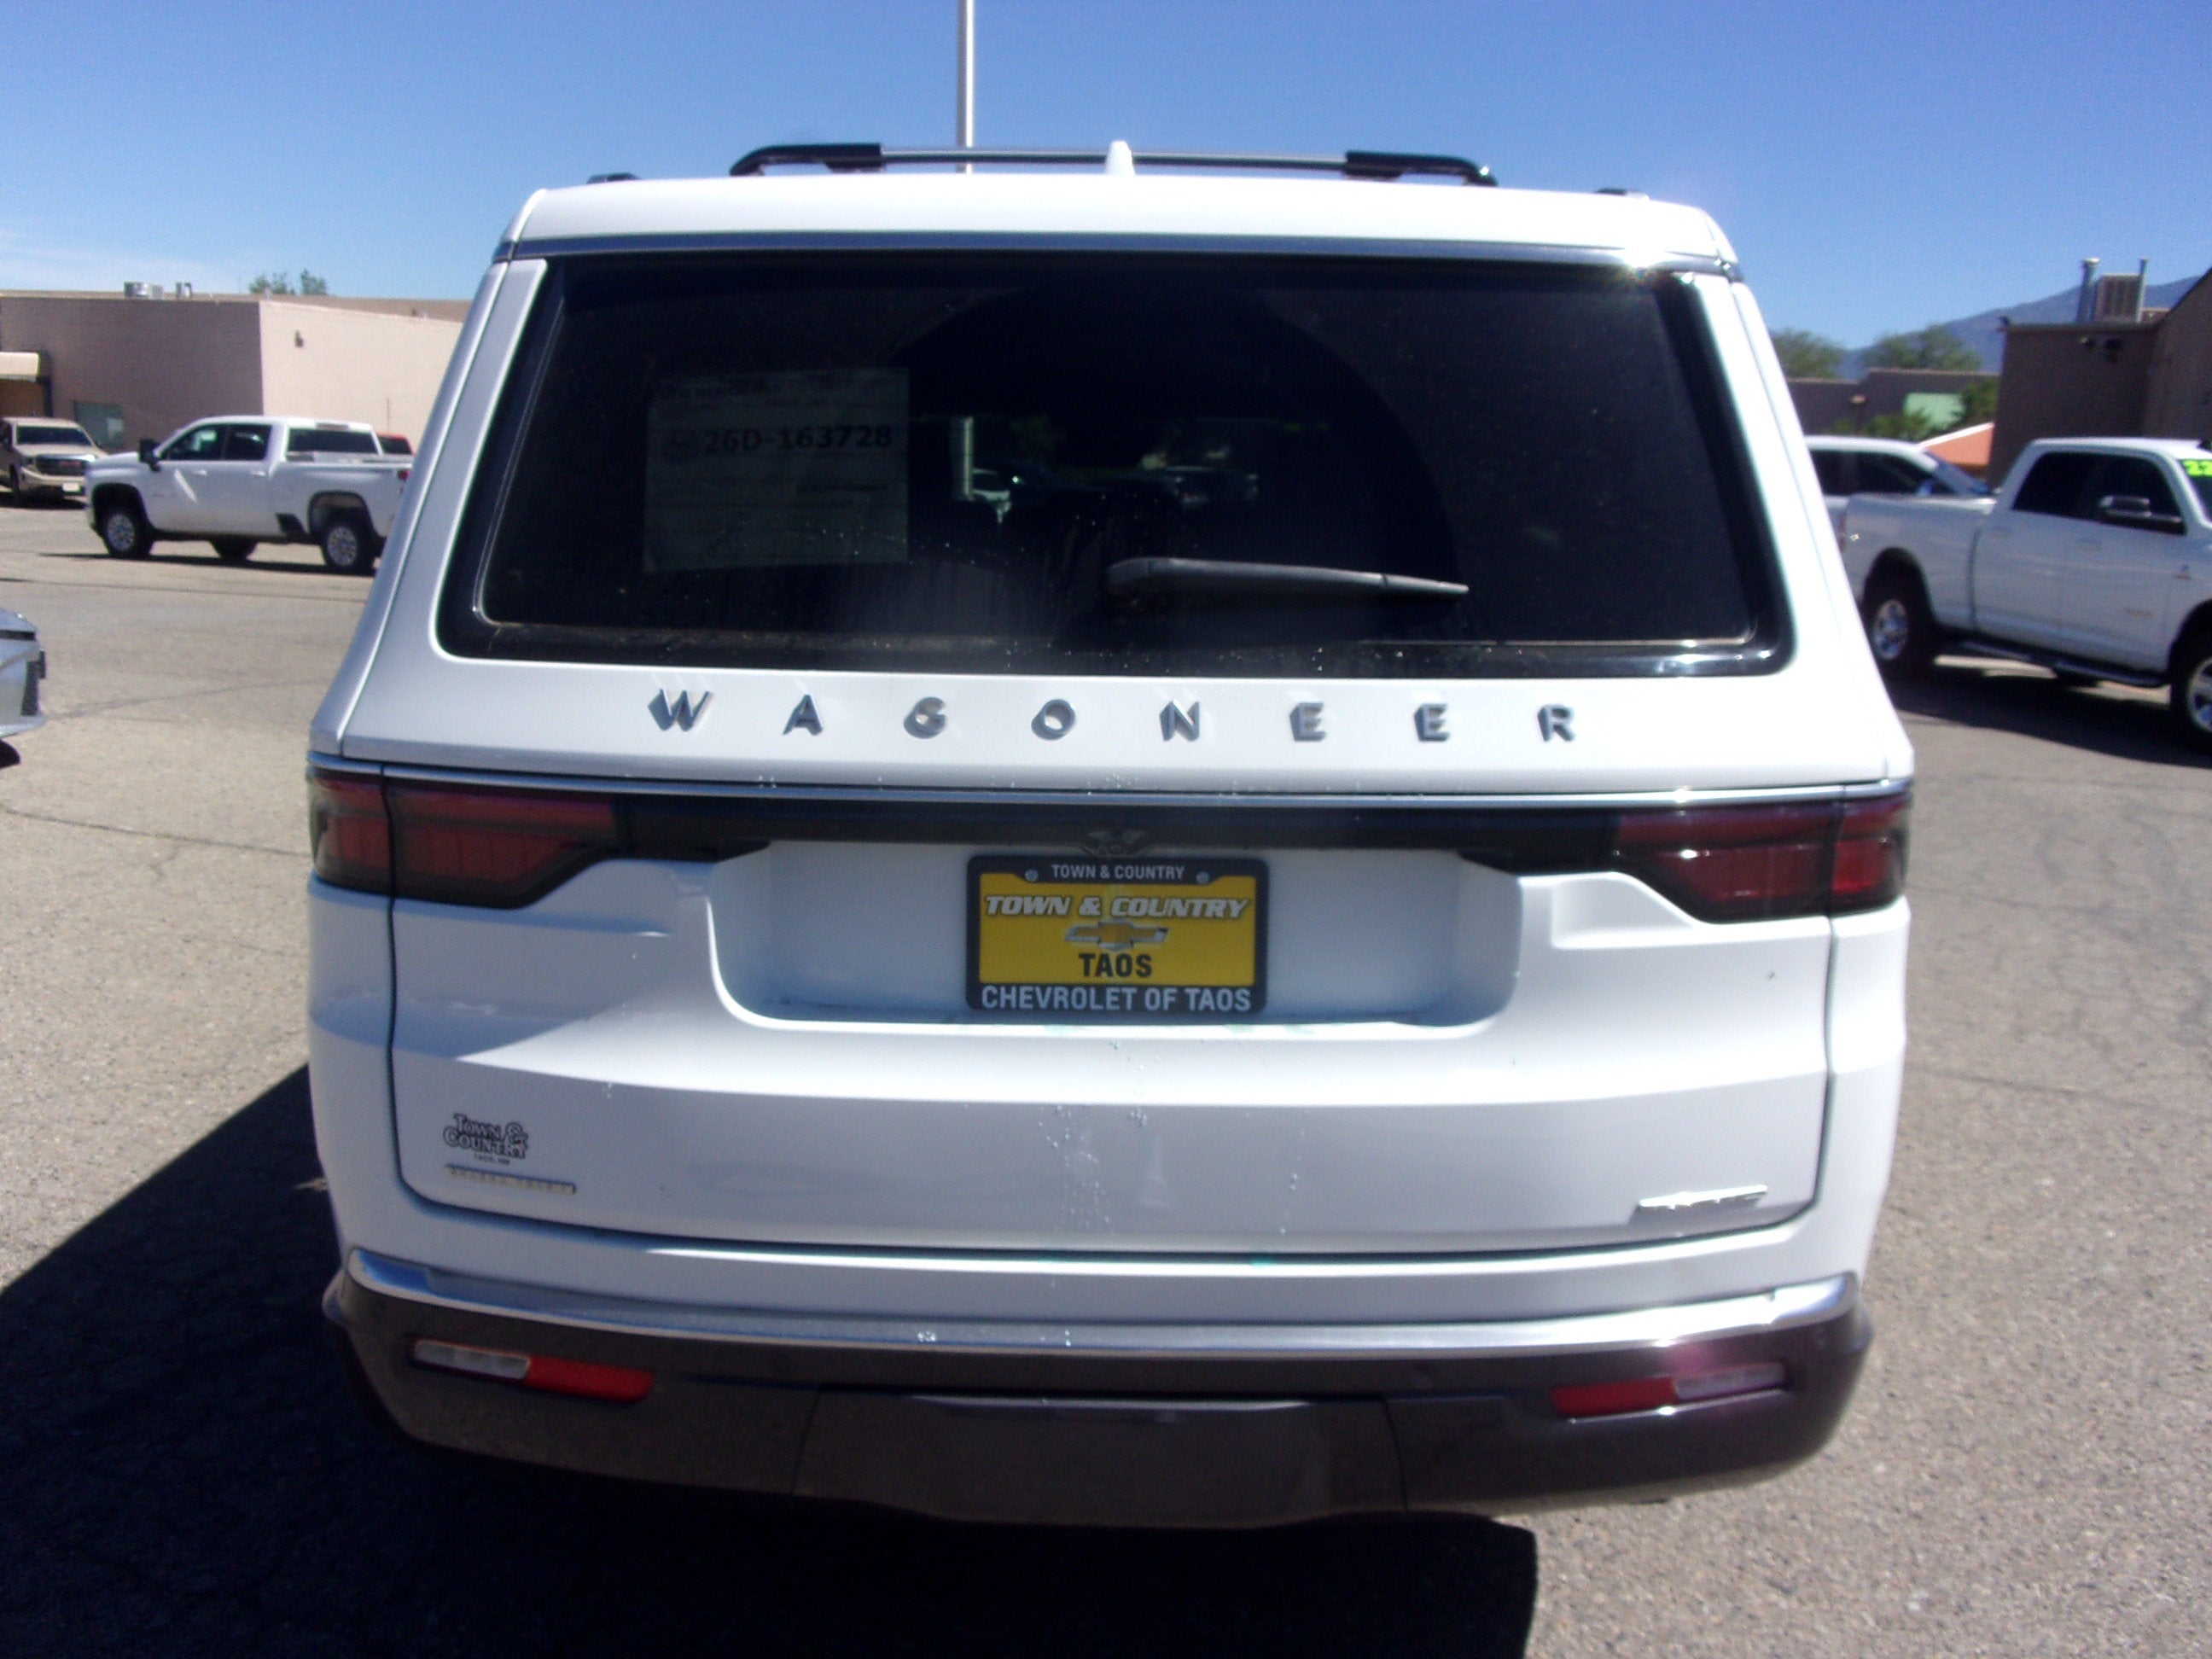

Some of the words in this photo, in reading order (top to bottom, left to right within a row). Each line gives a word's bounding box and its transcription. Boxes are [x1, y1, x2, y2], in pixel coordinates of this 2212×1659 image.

[650, 689, 1575, 741] WAGONEER
[1051, 864, 1096, 879] TOWN
[1100, 864, 1110, 879] &
[1114, 865, 1185, 880] COUNTRY
[986, 896, 1070, 916] TOWN
[1079, 896, 1101, 916] &
[1111, 897, 1249, 918] COUNTRY
[1078, 953, 1153, 977] TAOS
[981, 986, 1137, 1010] CHEVROLET
[1144, 987, 1177, 1010] OF
[1185, 987, 1251, 1011] TAOS
